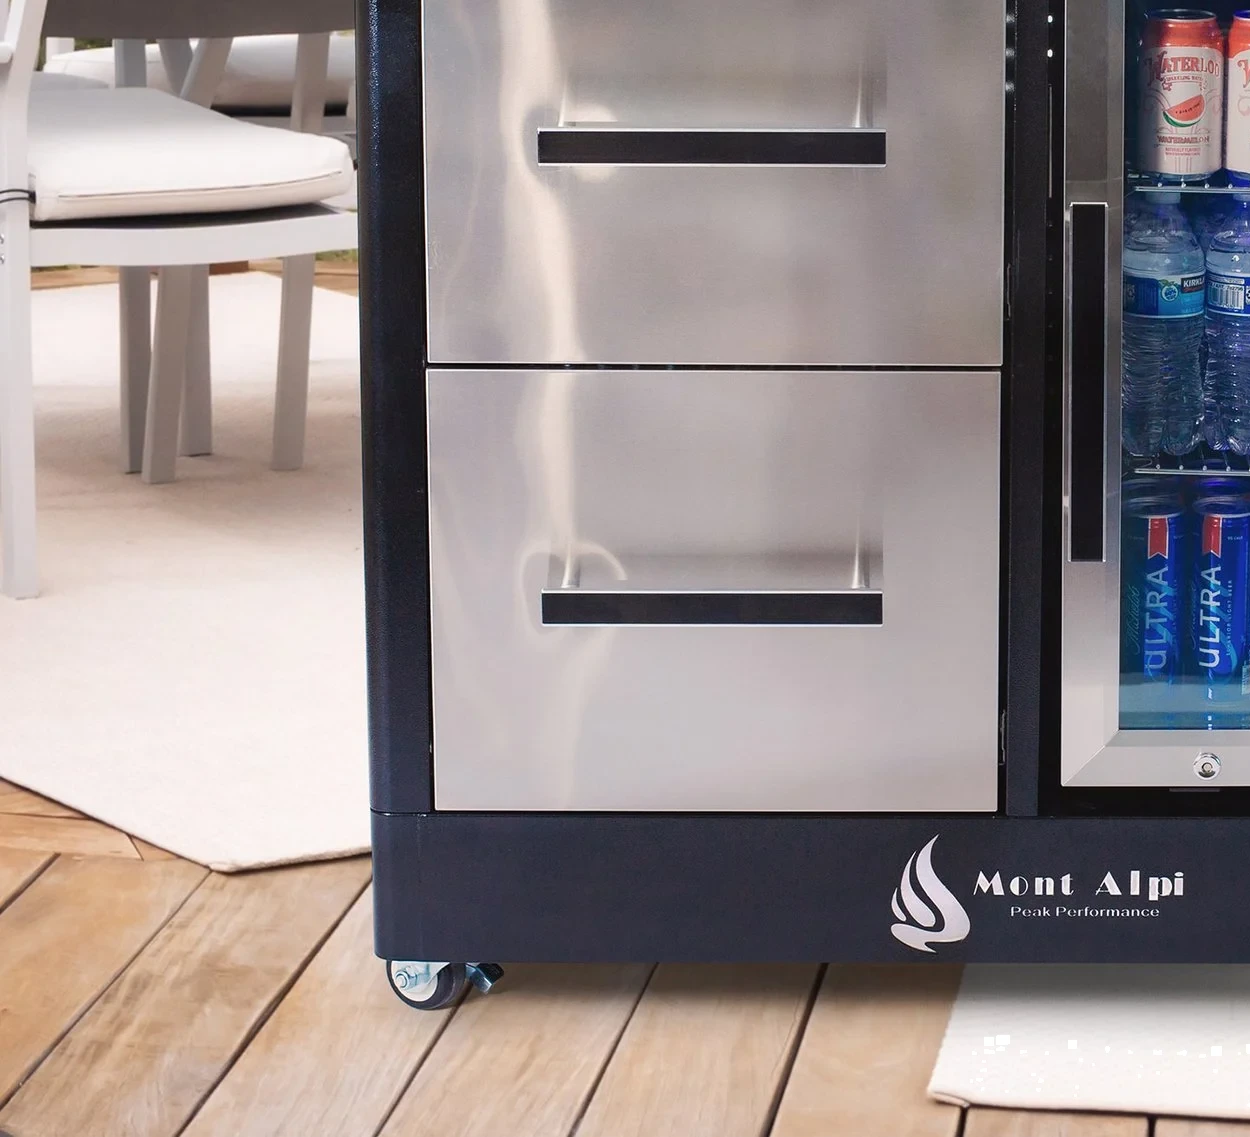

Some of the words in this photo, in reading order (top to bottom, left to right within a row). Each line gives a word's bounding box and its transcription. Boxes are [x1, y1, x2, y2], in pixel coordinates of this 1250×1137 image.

[1145, 51, 1219, 86] WATERLOO
[1157, 136, 1210, 144] WATERMELON
[1144, 565, 1169, 669] ULTRA
[1199, 564, 1221, 668] ULTRA
[973, 870, 1074, 896] Mont
[1095, 870, 1184, 901] Alpi
[1010, 906, 1051, 917] Peak
[1055, 906, 1160, 917] Performance
